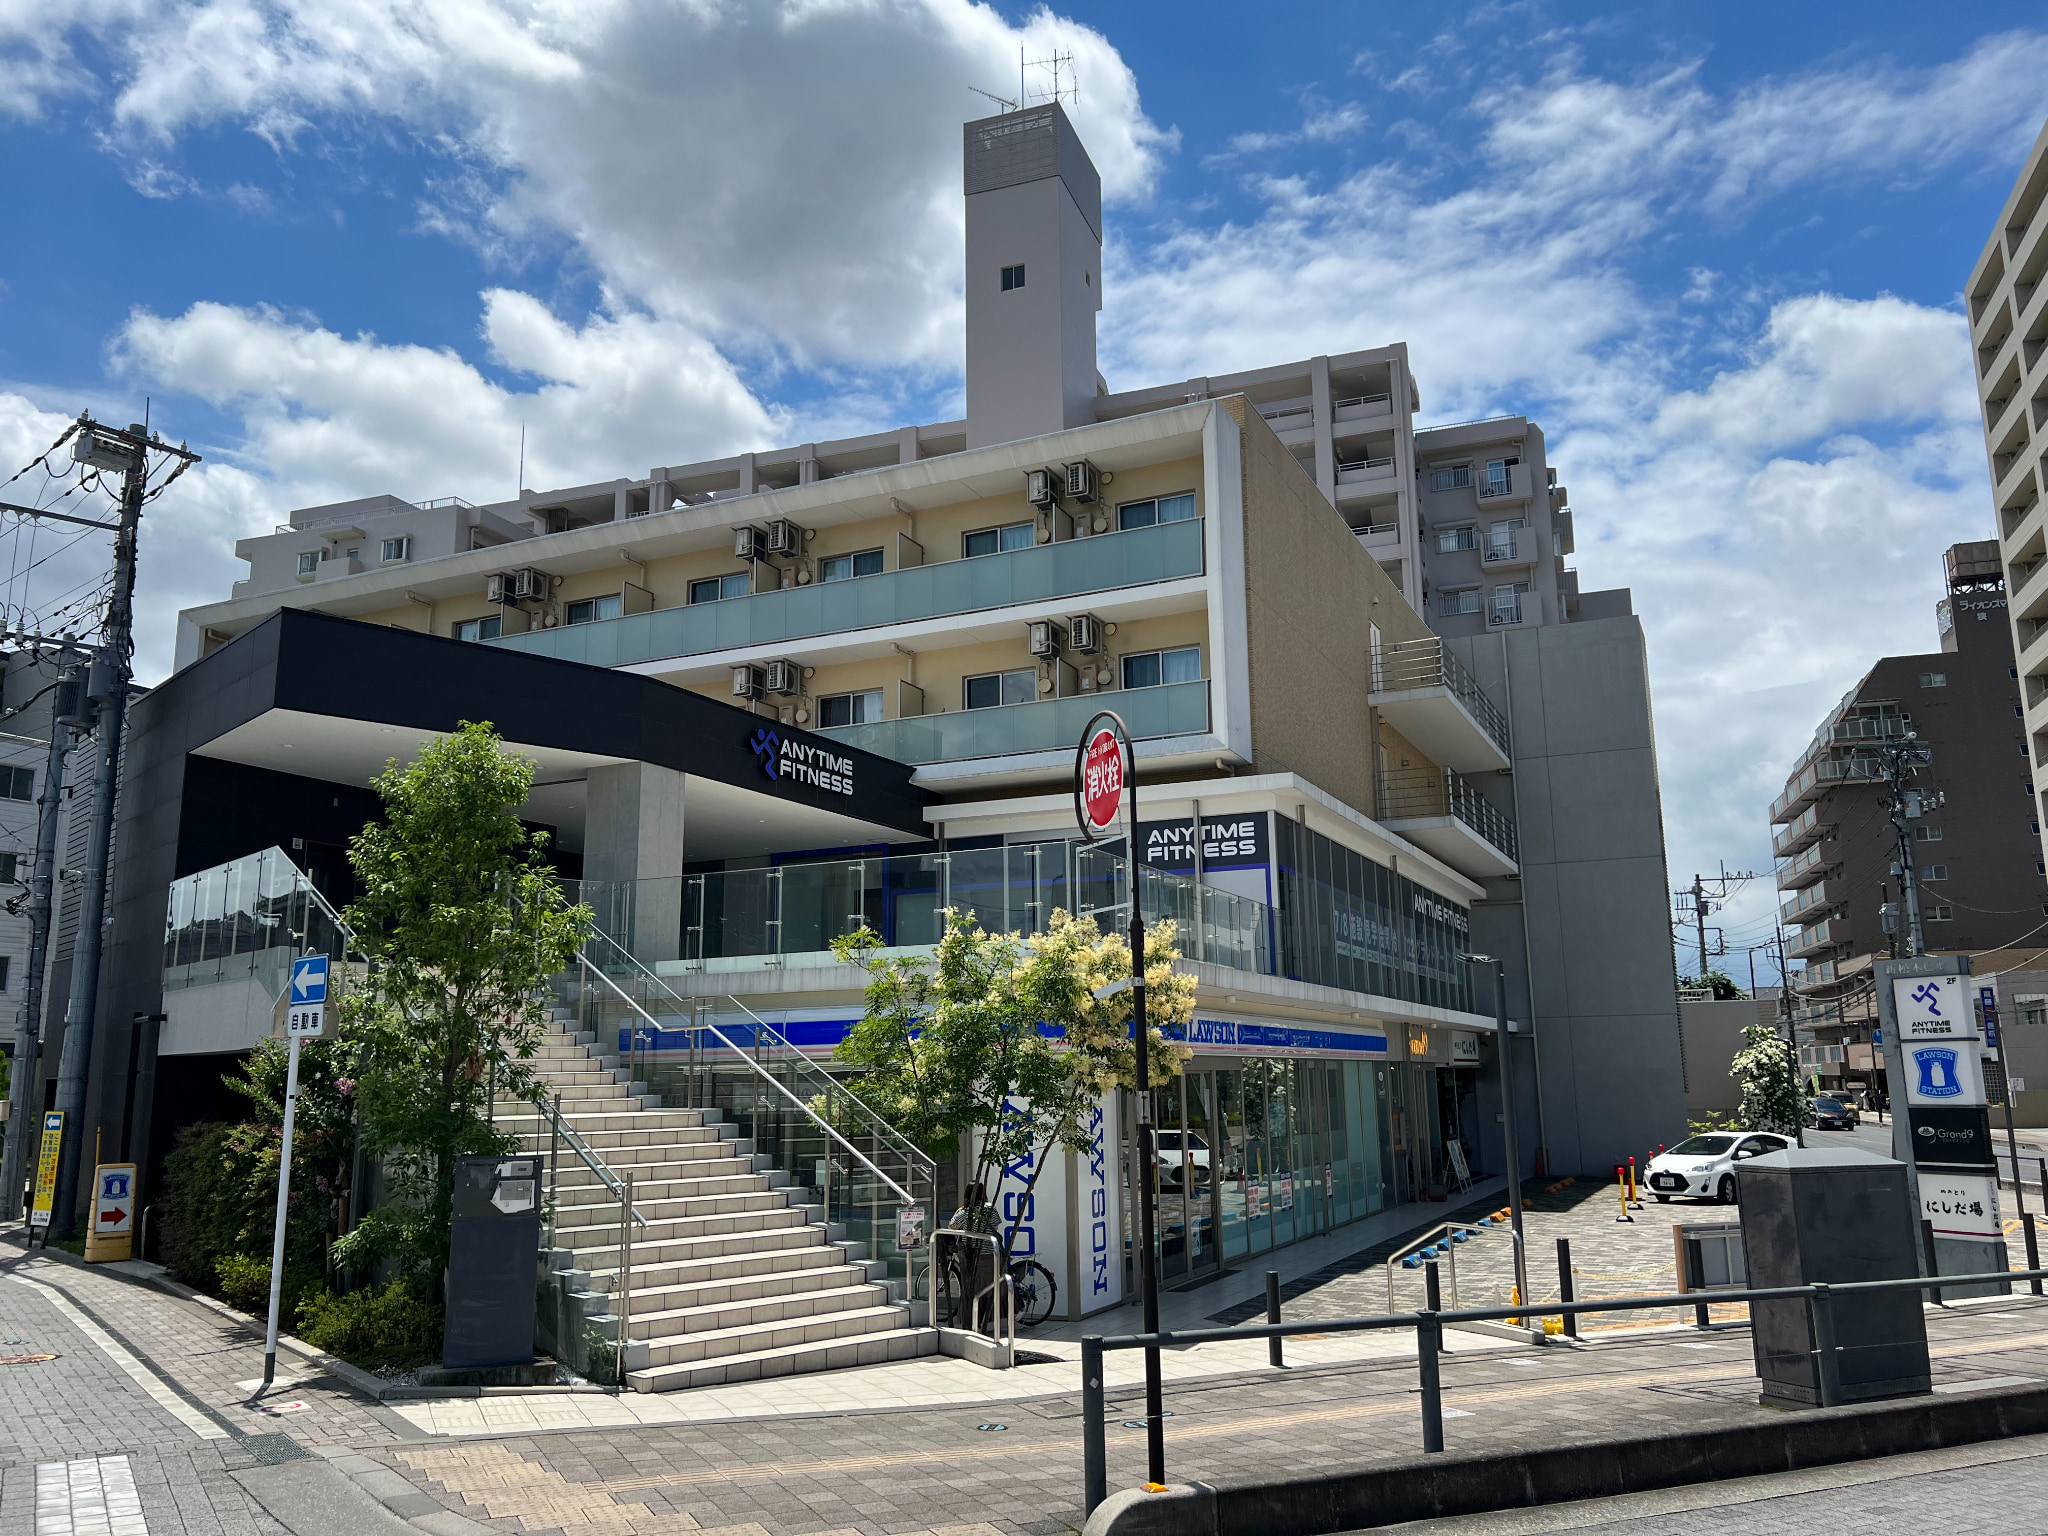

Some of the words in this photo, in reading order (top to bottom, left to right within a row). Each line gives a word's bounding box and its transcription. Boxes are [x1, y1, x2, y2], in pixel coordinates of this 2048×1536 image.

[780, 739, 853, 776] ANYTIME
[1089, 747, 1098, 760] FIRE
[1098, 739, 1115, 756] HYDRANT
[780, 759, 854, 796] FITNESS
[1087, 755, 1120, 803] 消火栓
[1147, 821, 1255, 845] ANYTIME
[1147, 839, 1256, 862] FITNESS
[1414, 893, 1443, 922] ANYTIME
[1443, 907, 1469, 933] FITNESS
[1946, 977, 1957, 985] 2F
[291, 1012, 319, 1031] 自動車
[1188, 1019, 1236, 1044] LAWSON
[1911, 1020, 1951, 1028] ANYTIME
[1916, 1050, 1955, 1061] LAWSON
[1921, 1085, 1958, 1095] STATION
[1938, 1128, 1974, 1139] Grand9
[1089, 1096, 1108, 1296] AWSON
[1926, 1200, 1984, 1217] にしだ場
